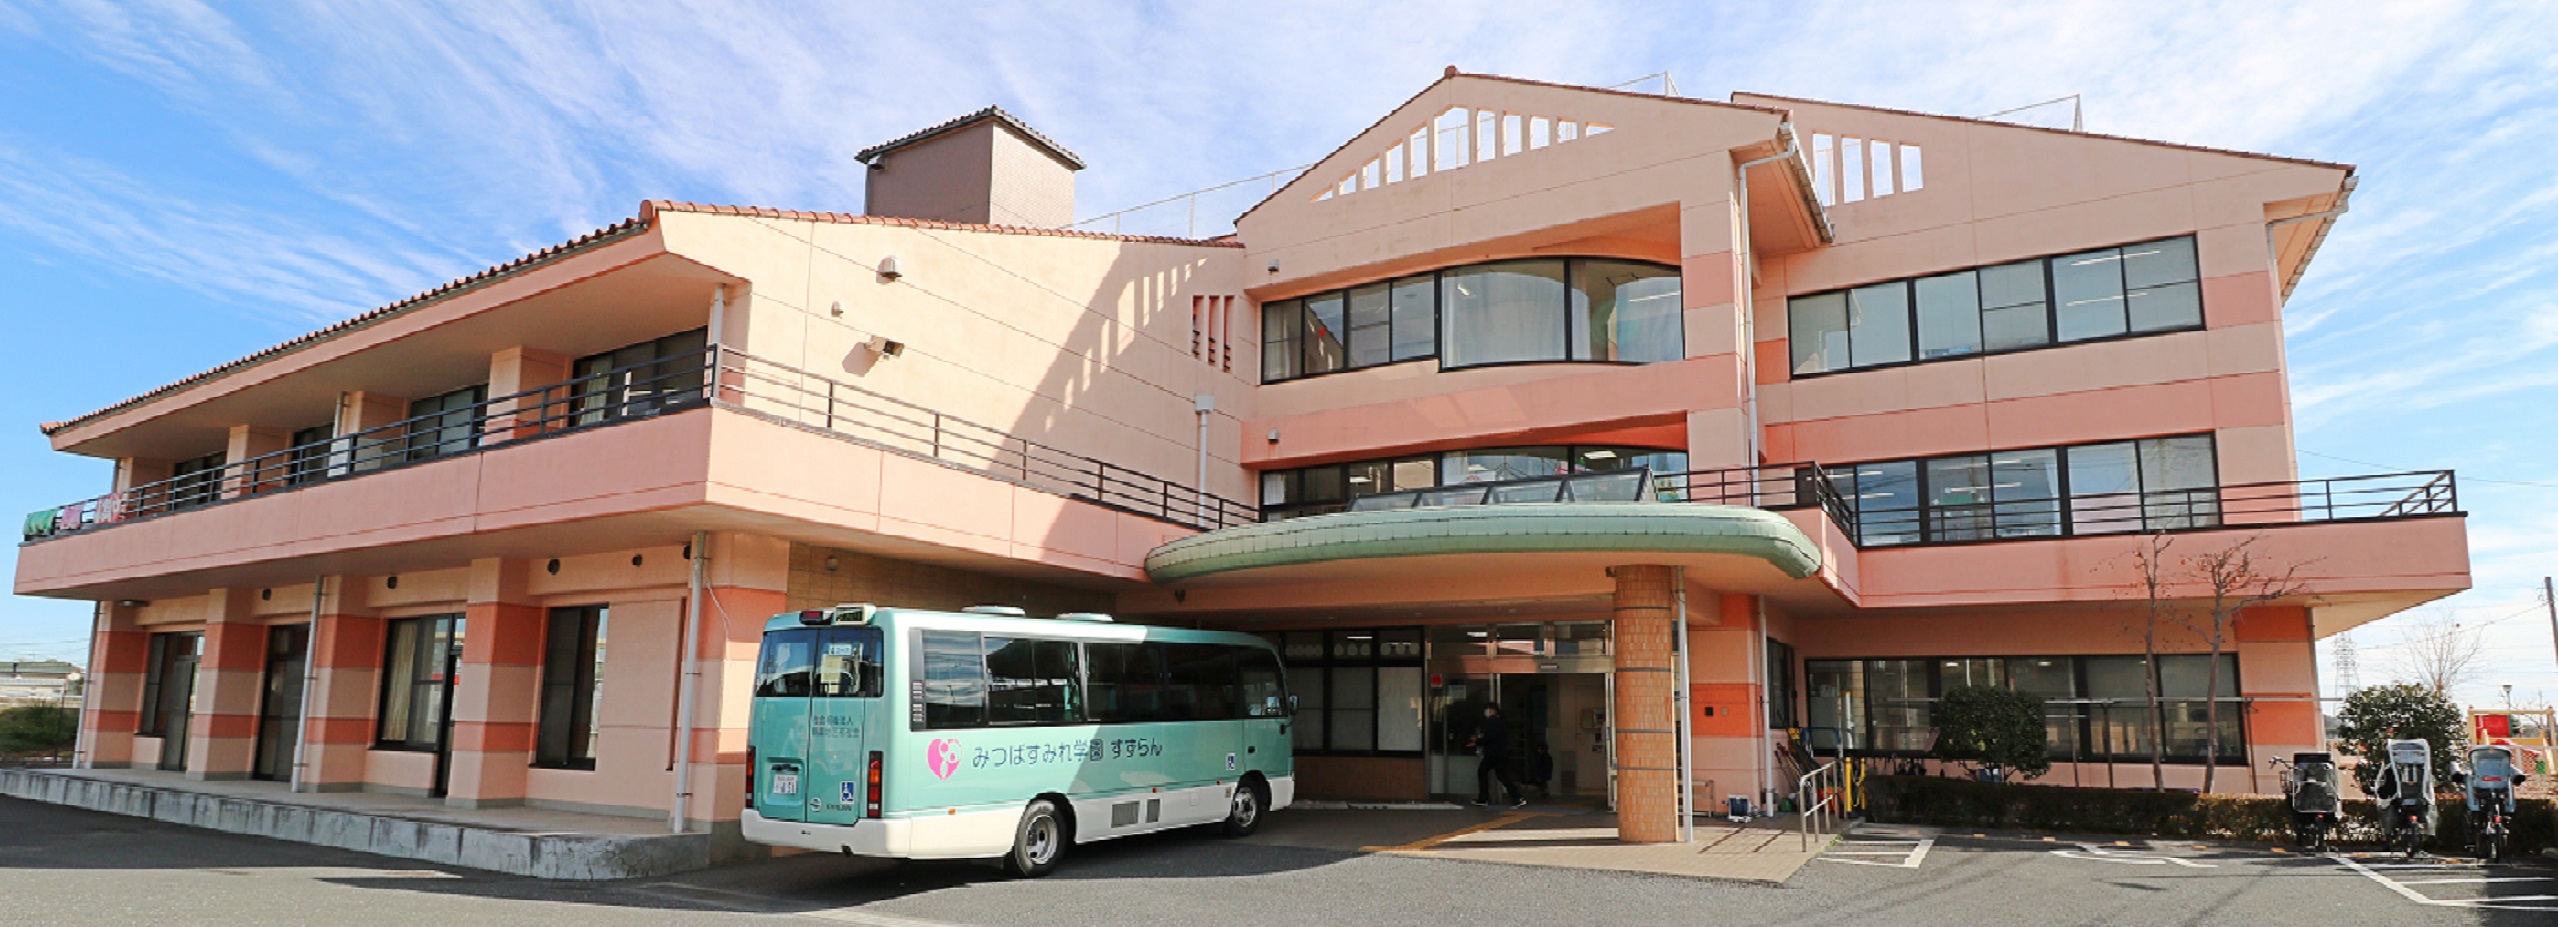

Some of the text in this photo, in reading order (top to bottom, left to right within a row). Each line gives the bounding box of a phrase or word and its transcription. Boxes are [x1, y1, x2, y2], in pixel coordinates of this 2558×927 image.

[972, 737, 1163, 769] みつばすみれ学園 すずらん
